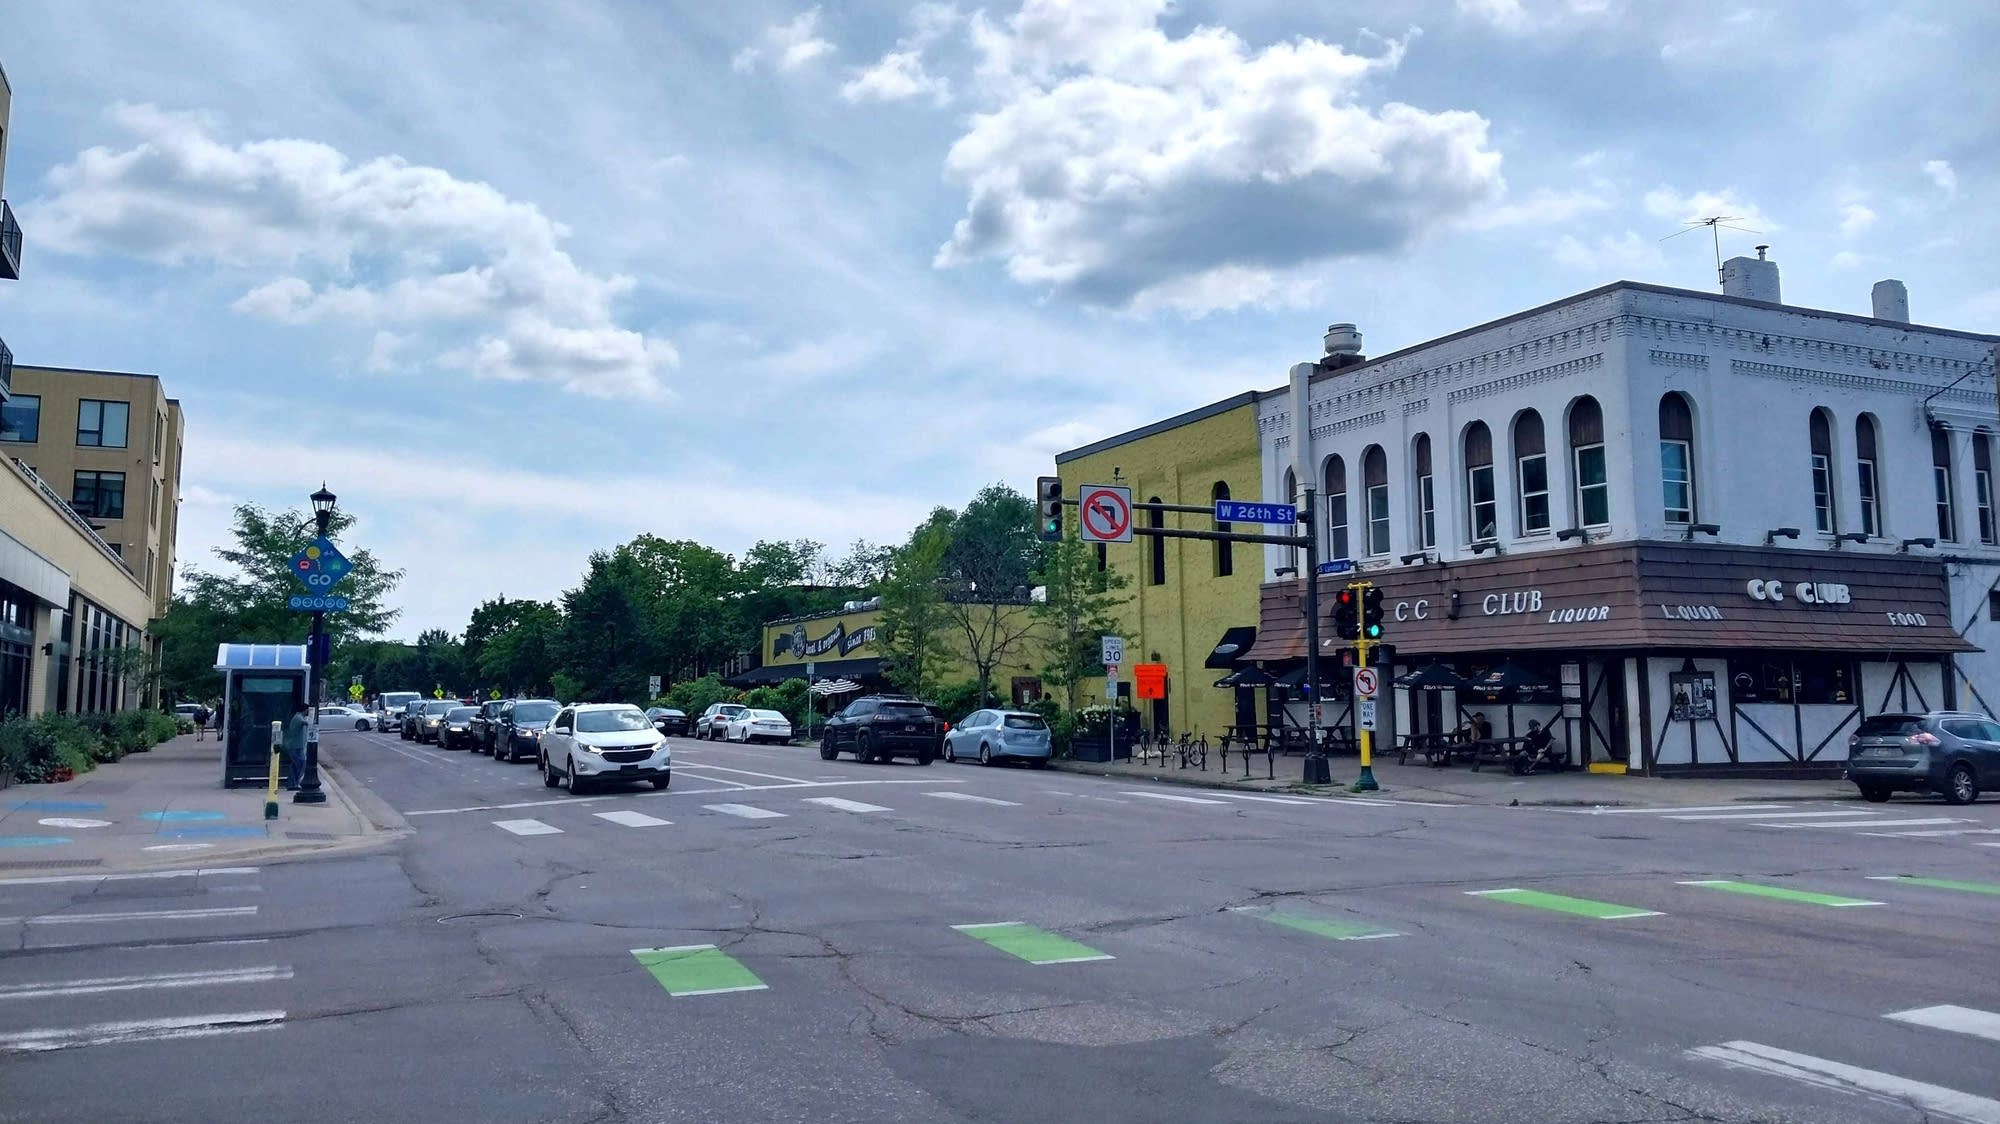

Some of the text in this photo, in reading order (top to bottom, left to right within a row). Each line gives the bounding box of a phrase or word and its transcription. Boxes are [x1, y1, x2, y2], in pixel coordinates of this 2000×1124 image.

[1221, 505, 1293, 521] W 26th St
[308, 574, 331, 586] GO
[1747, 578, 1851, 604] CC CLUB
[1483, 590, 1543, 615] CLUB
[1548, 606, 1610, 624] LIQUOR
[1661, 604, 1723, 620] LQUOR
[1886, 612, 1927, 626] FOOD
[1105, 651, 1120, 661] 30
